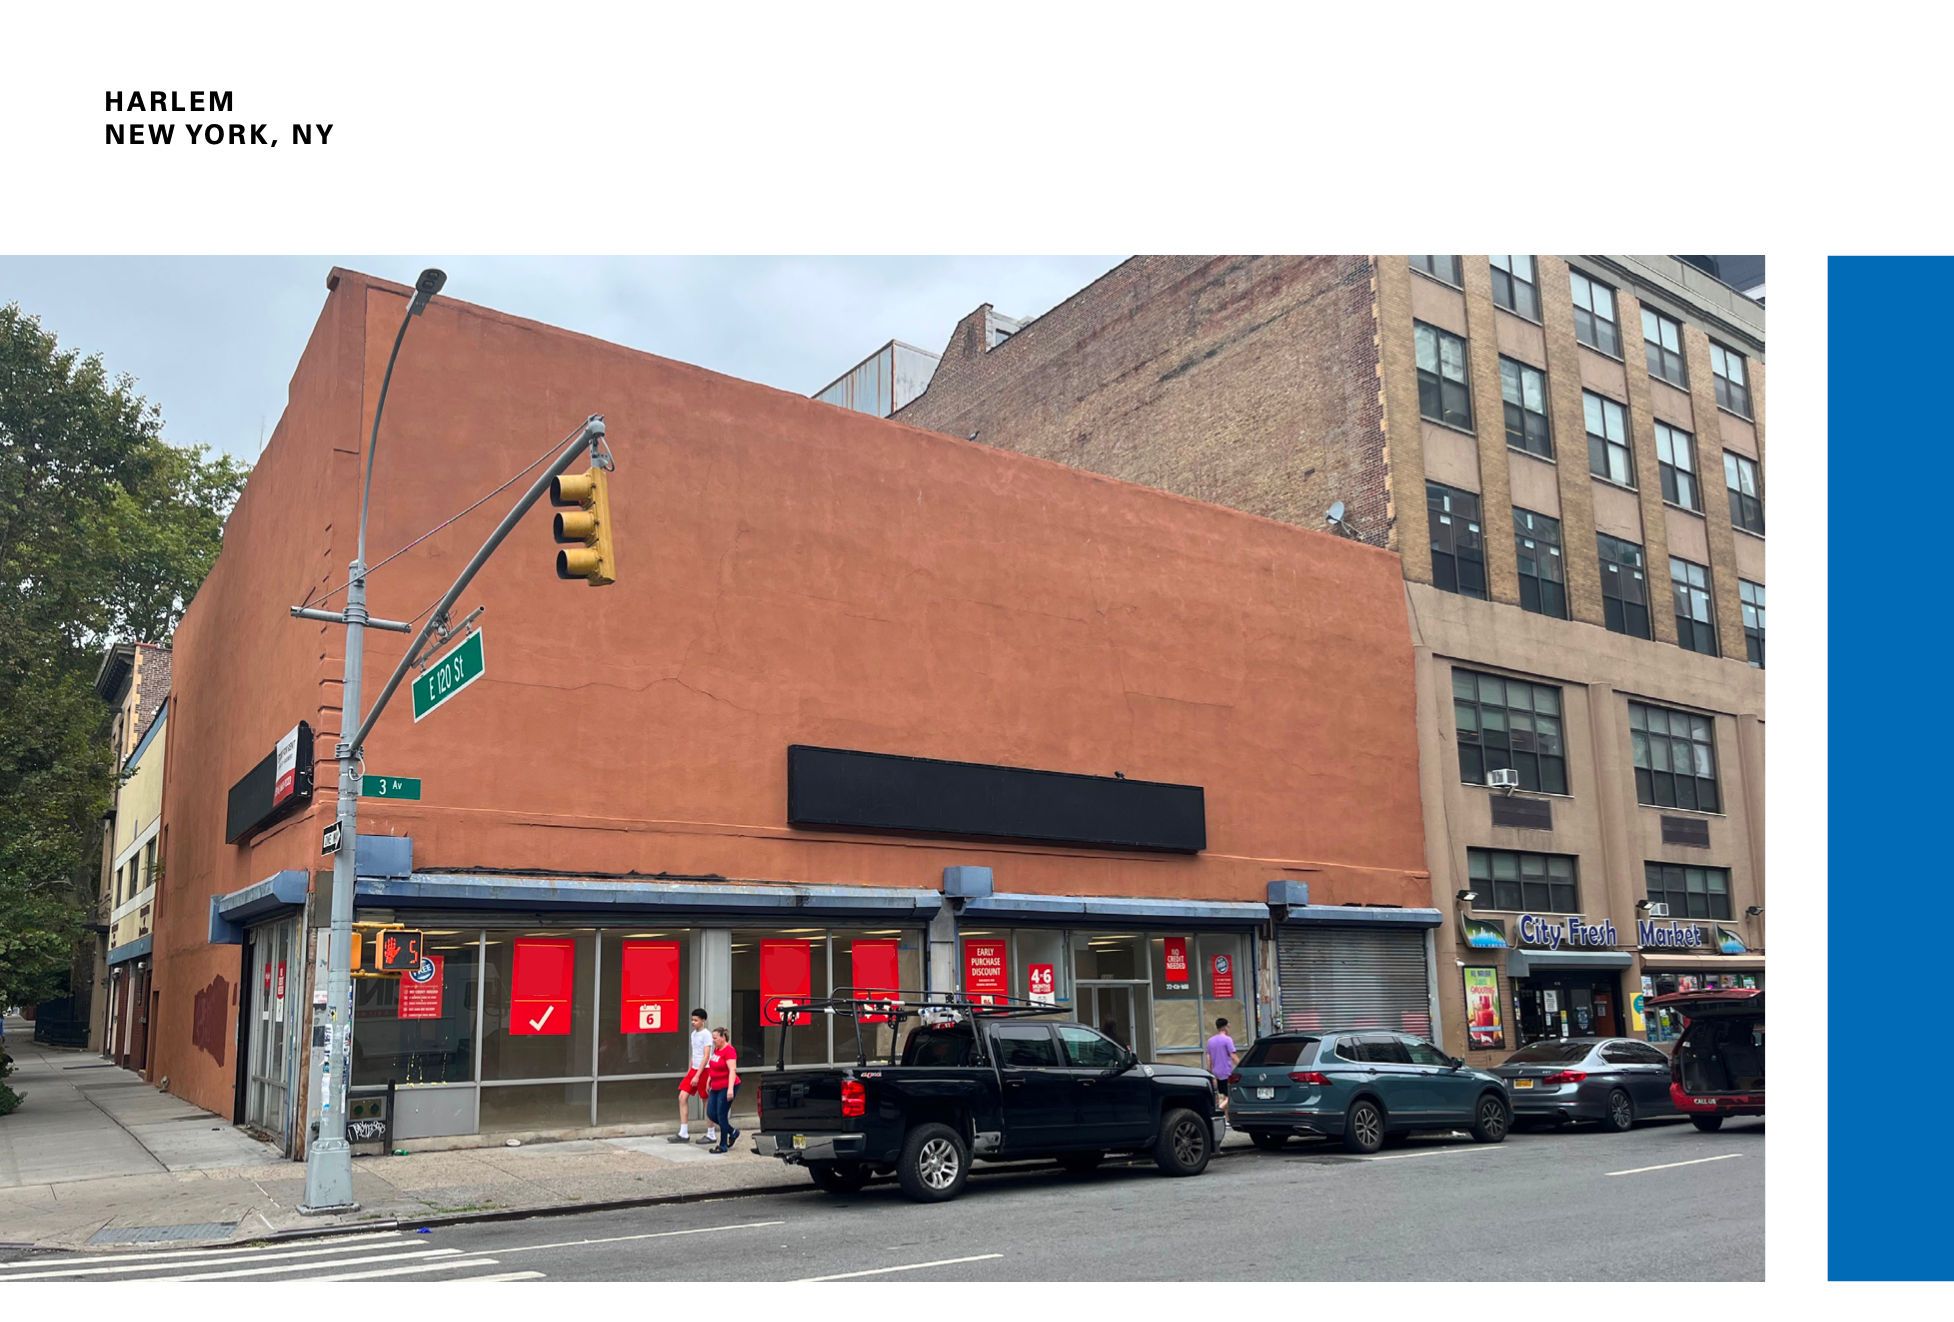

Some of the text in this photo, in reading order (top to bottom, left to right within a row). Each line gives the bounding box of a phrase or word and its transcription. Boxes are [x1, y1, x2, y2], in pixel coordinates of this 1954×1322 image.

[429, 654, 464, 701] E 120 St
[378, 779, 402, 795] 3 Av
[1520, 914, 1702, 950] City Fresh Market
[409, 940, 418, 964] 5
[976, 948, 994, 957] EARLY
[971, 958, 1001, 966] PURCHASE
[413, 963, 432, 977] REE
[971, 968, 1001, 976] DISCOUNT
[1030, 968, 1052, 984] 4-6
[646, 1013, 654, 1025] 6
